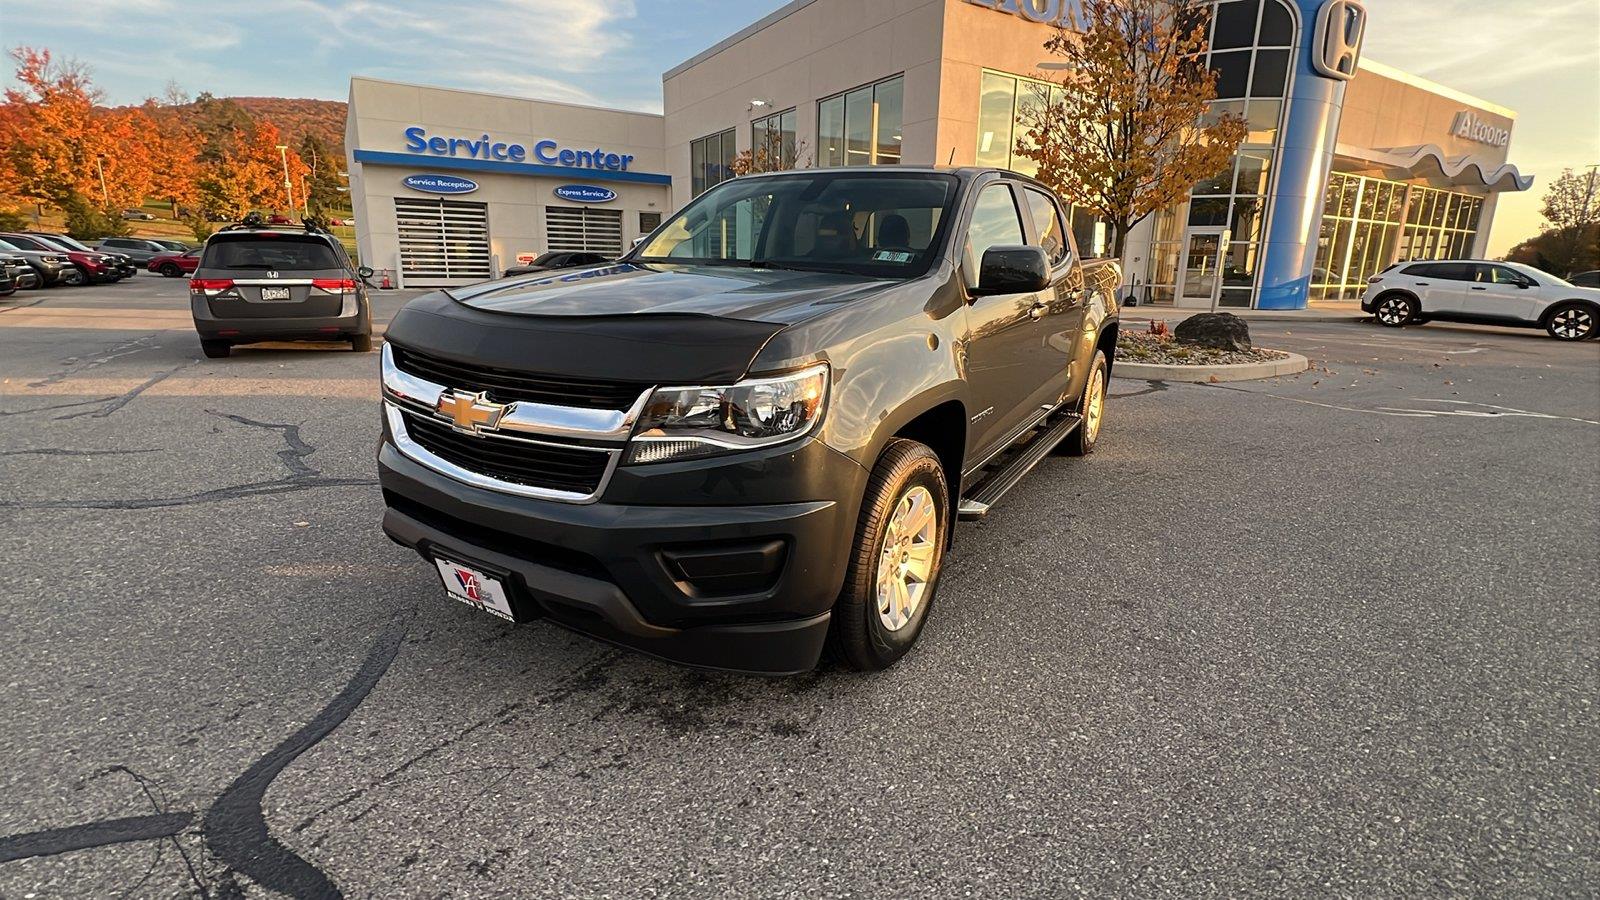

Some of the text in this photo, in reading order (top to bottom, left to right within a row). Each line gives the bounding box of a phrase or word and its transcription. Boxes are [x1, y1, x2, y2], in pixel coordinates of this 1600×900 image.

[1457, 111, 1508, 146] Altoona
[405, 127, 634, 171] Service Center
[407, 177, 475, 190] Service Reception
[557, 188, 605, 199] Express Service
